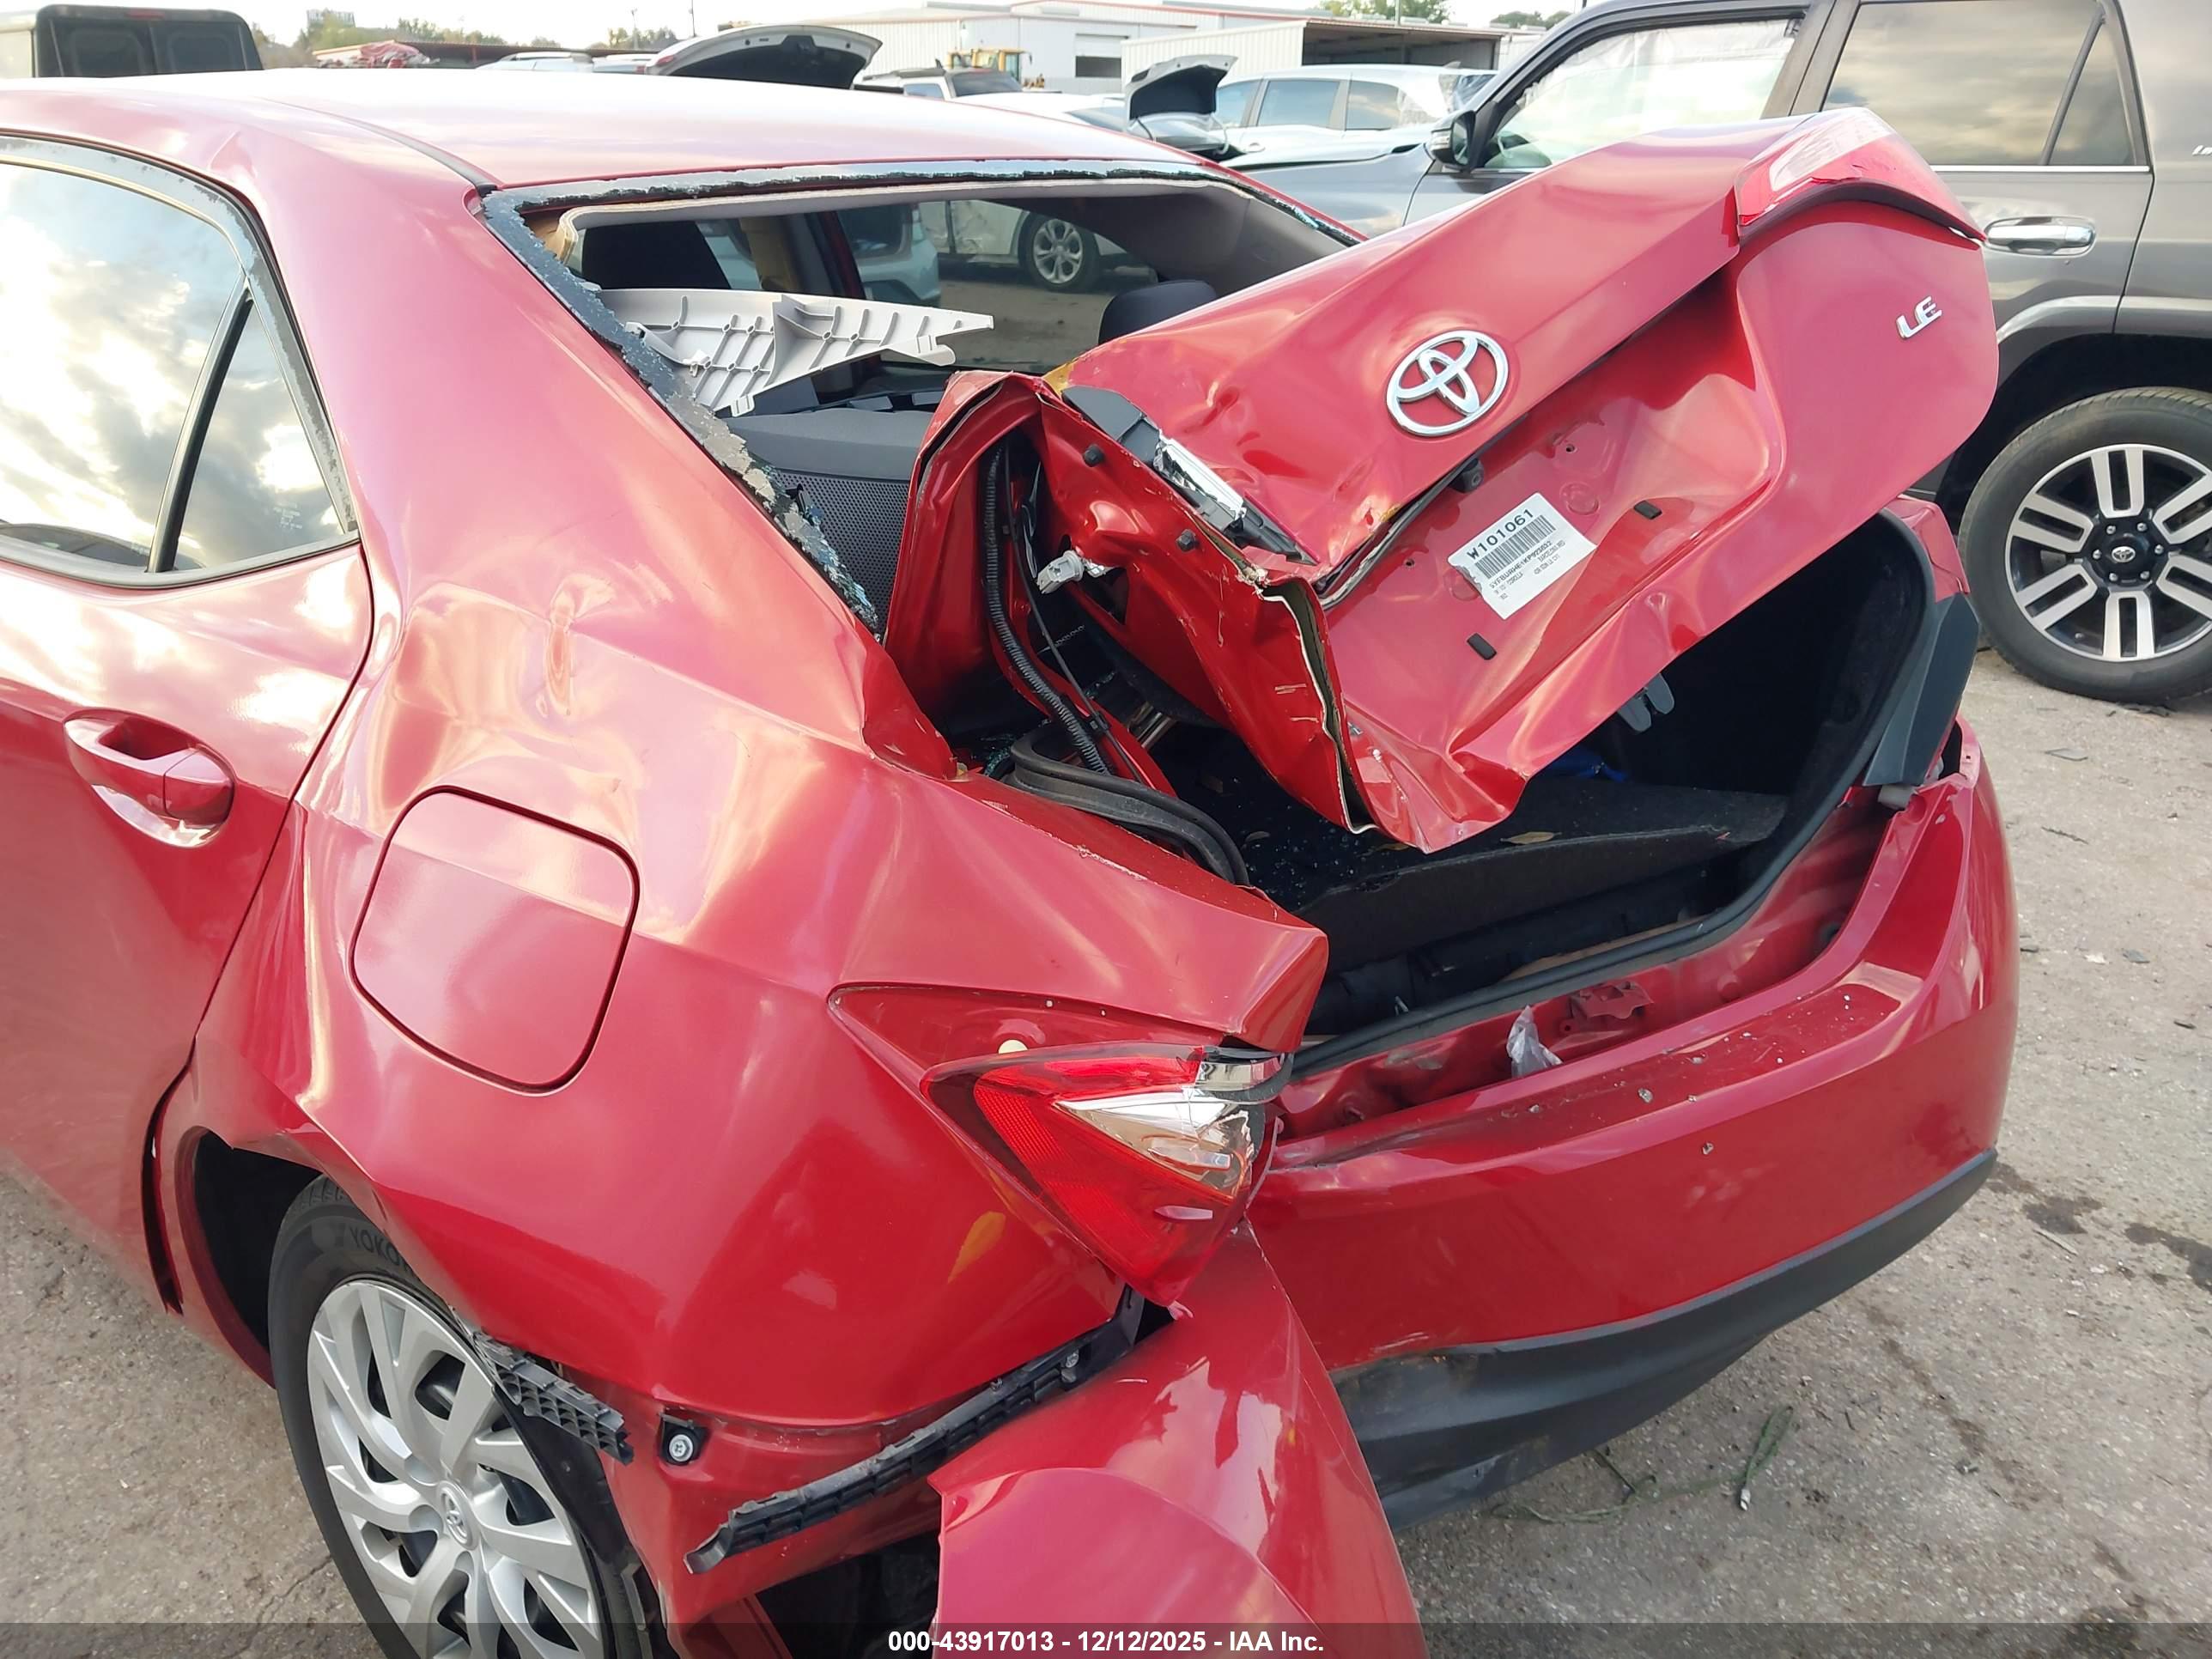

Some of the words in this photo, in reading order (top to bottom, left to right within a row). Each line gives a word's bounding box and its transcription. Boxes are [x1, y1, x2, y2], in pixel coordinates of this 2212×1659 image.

[1896, 295, 1942, 338] LE
[1467, 508, 1534, 561] W101061
[349, 1226, 407, 1271] YOKO
